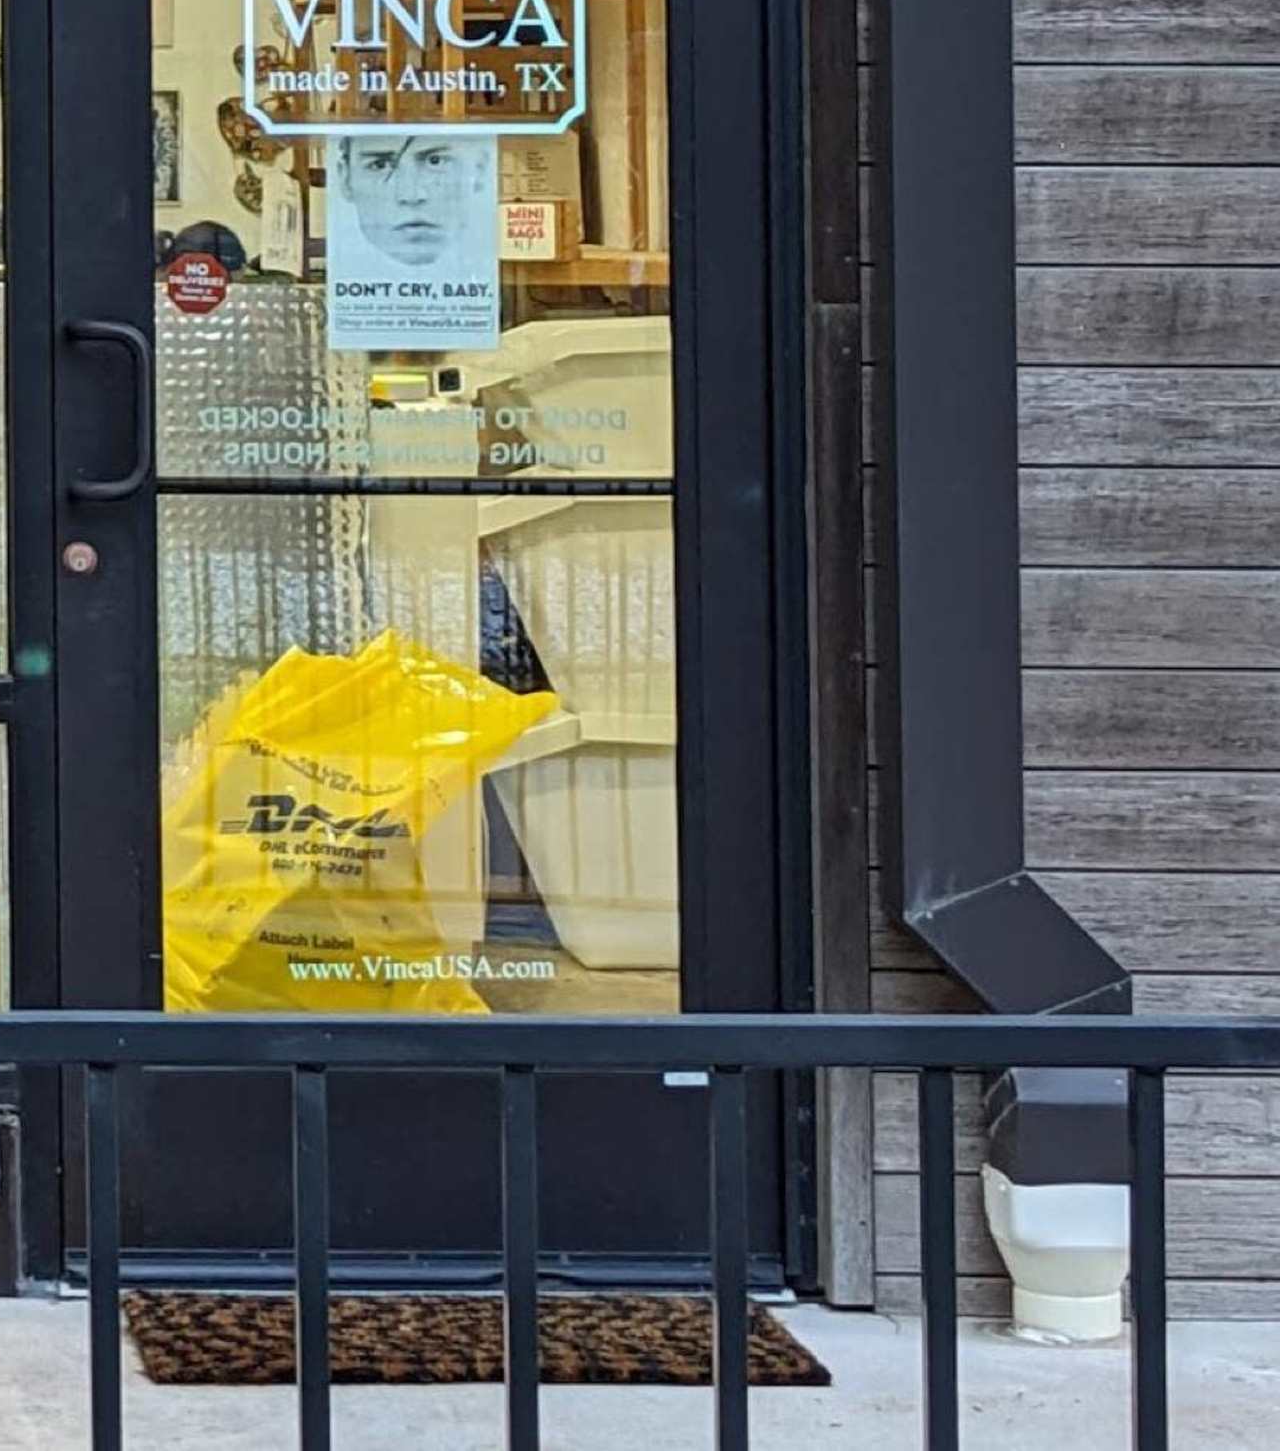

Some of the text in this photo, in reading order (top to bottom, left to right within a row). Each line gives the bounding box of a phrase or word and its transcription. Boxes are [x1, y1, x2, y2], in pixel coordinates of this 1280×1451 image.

[268, 62, 566, 96] made in Austin, TX
[186, 263, 209, 275] NO
[335, 282, 493, 299] DON'T CRY, BABY.
[259, 930, 354, 950] Attach Label
[288, 954, 555, 981] www.VincaUSA.com
